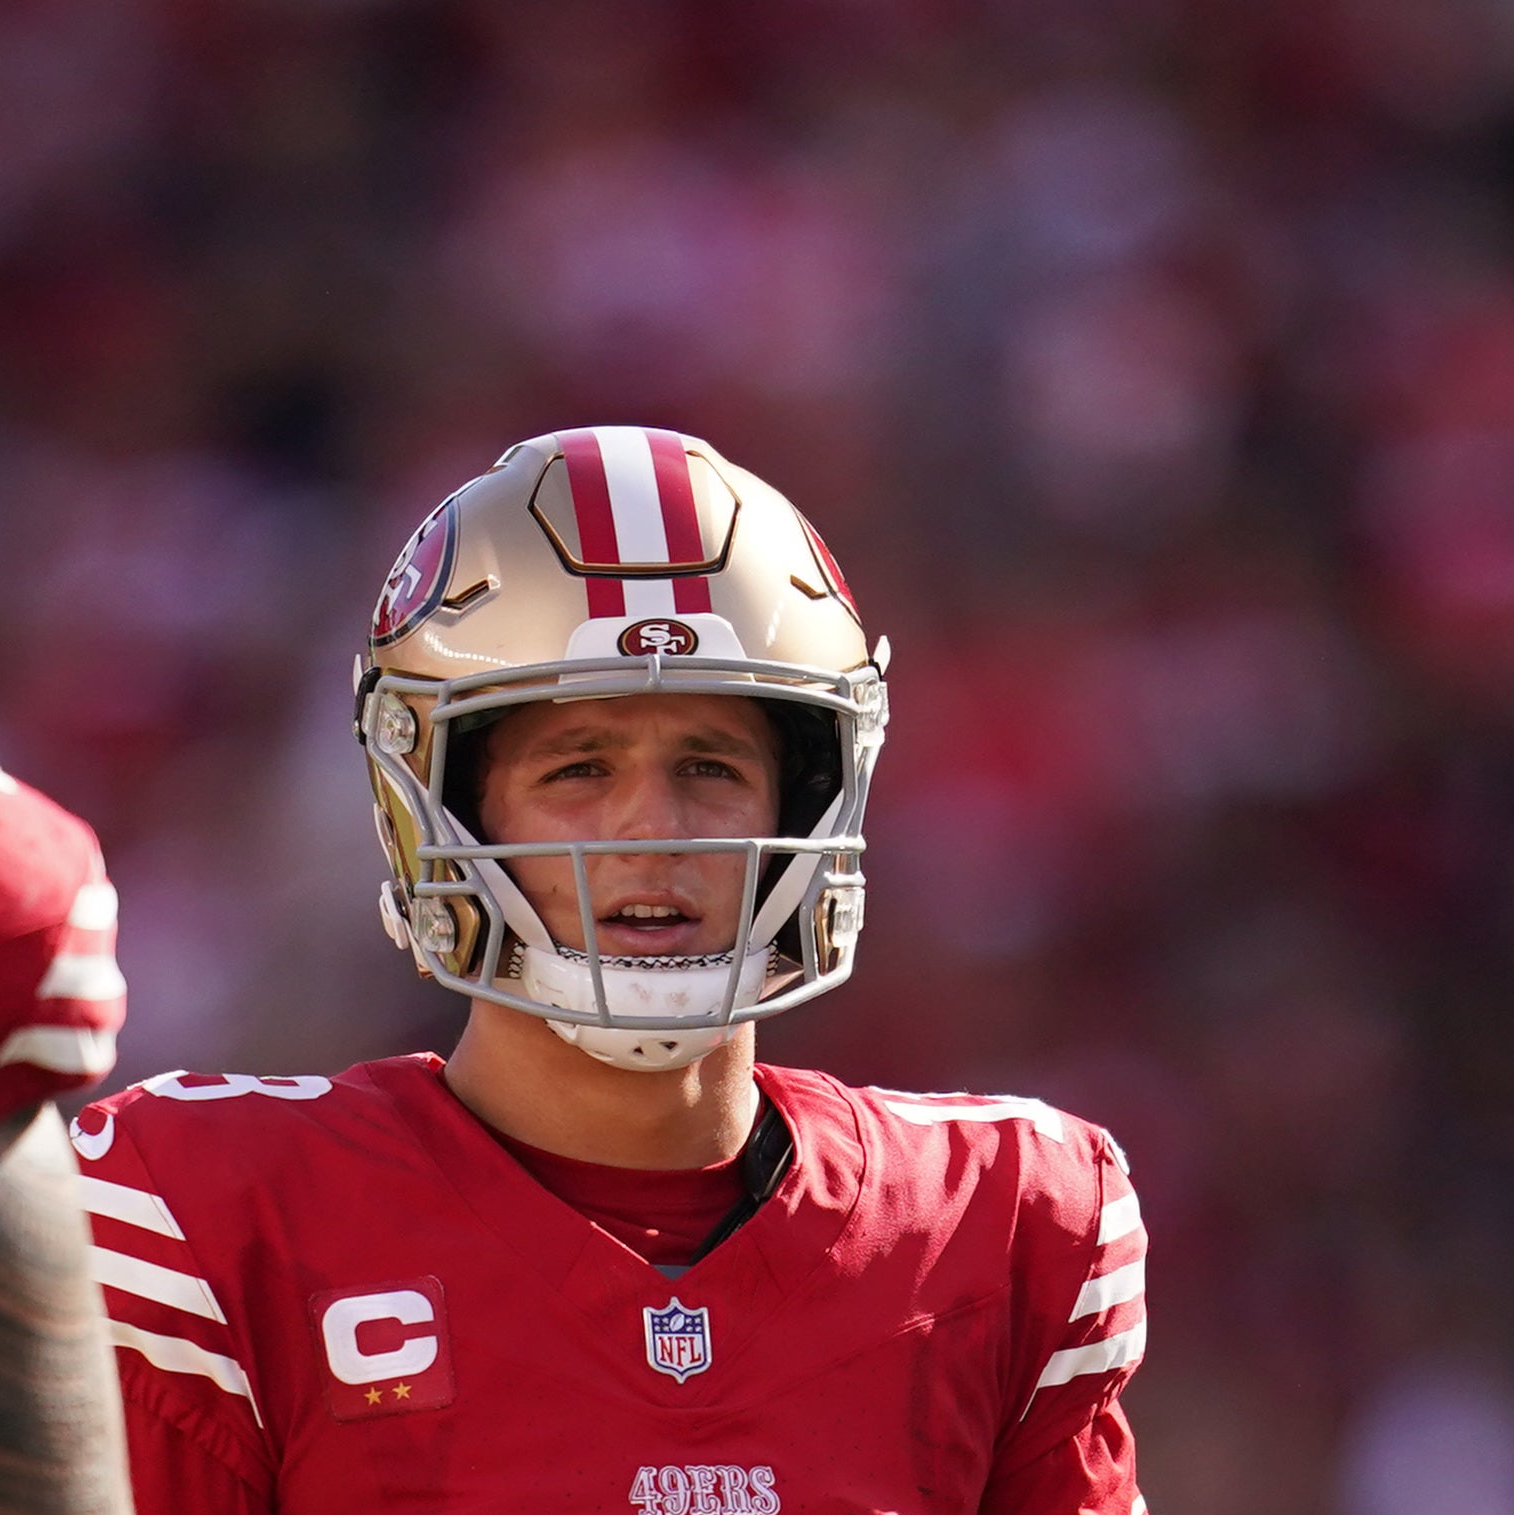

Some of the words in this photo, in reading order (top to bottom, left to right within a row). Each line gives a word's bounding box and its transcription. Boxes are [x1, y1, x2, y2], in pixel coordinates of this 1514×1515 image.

[639, 623, 686, 656] SF
[322, 1291, 438, 1384] C
[658, 1336, 703, 1367] NFL
